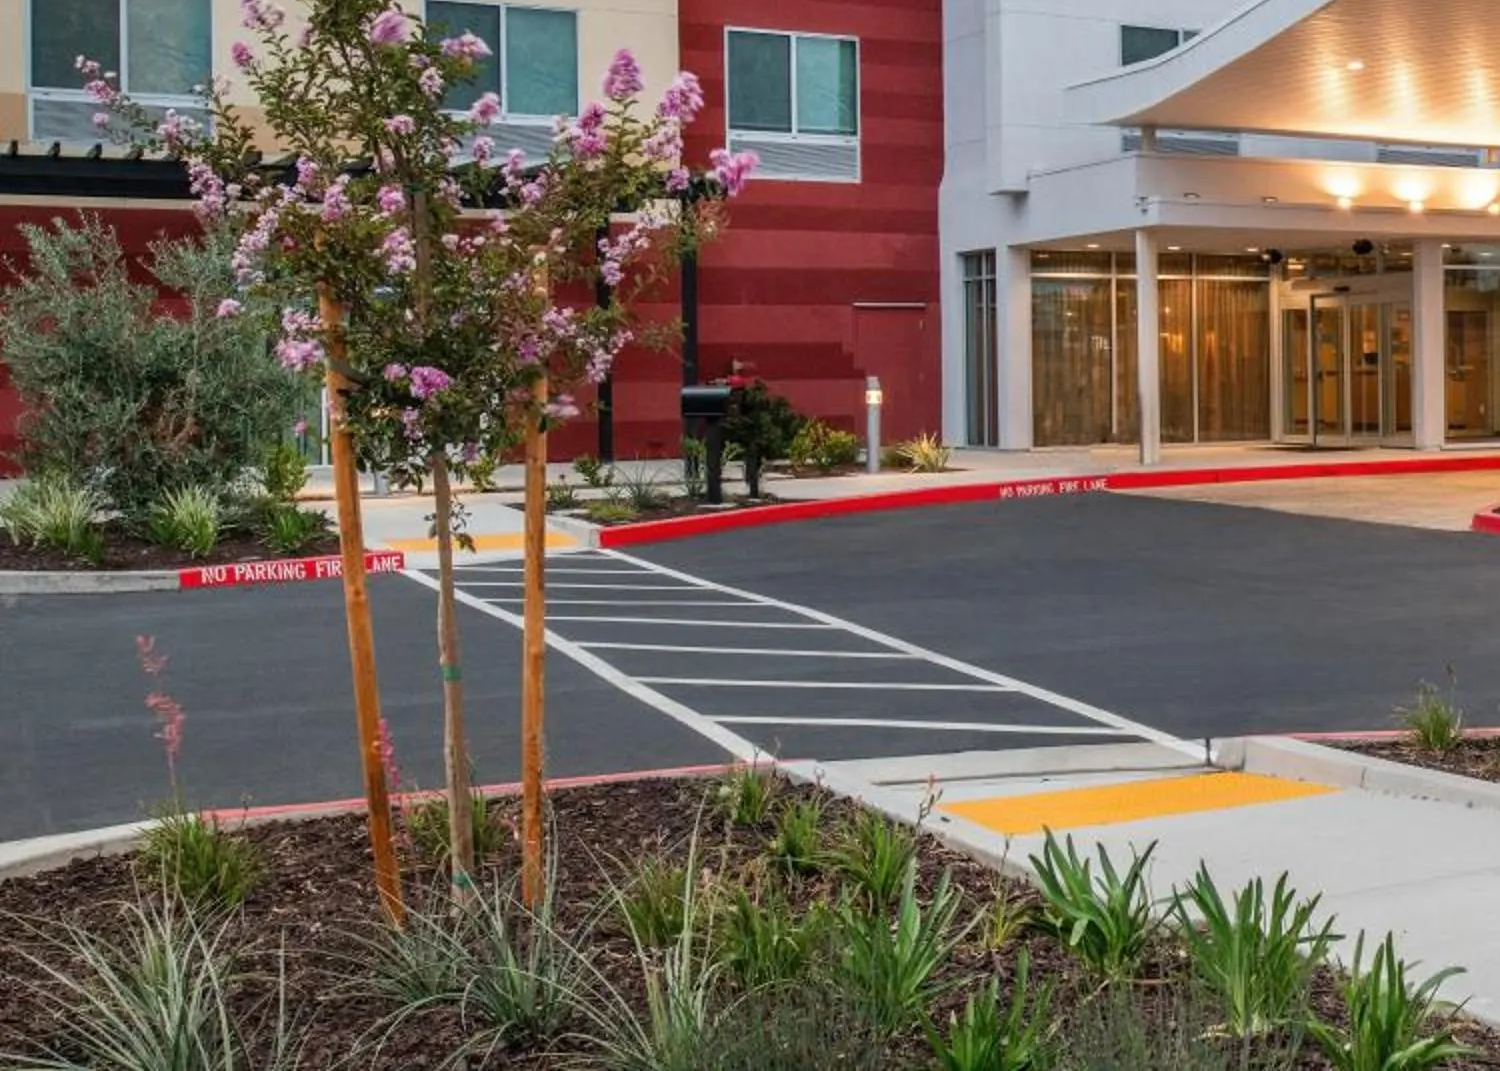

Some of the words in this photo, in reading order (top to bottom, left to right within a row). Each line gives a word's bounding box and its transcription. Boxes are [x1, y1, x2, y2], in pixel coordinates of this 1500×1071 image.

[201, 566, 226, 584] NO
[235, 562, 306, 581] PARKING
[315, 560, 343, 578] FIR
